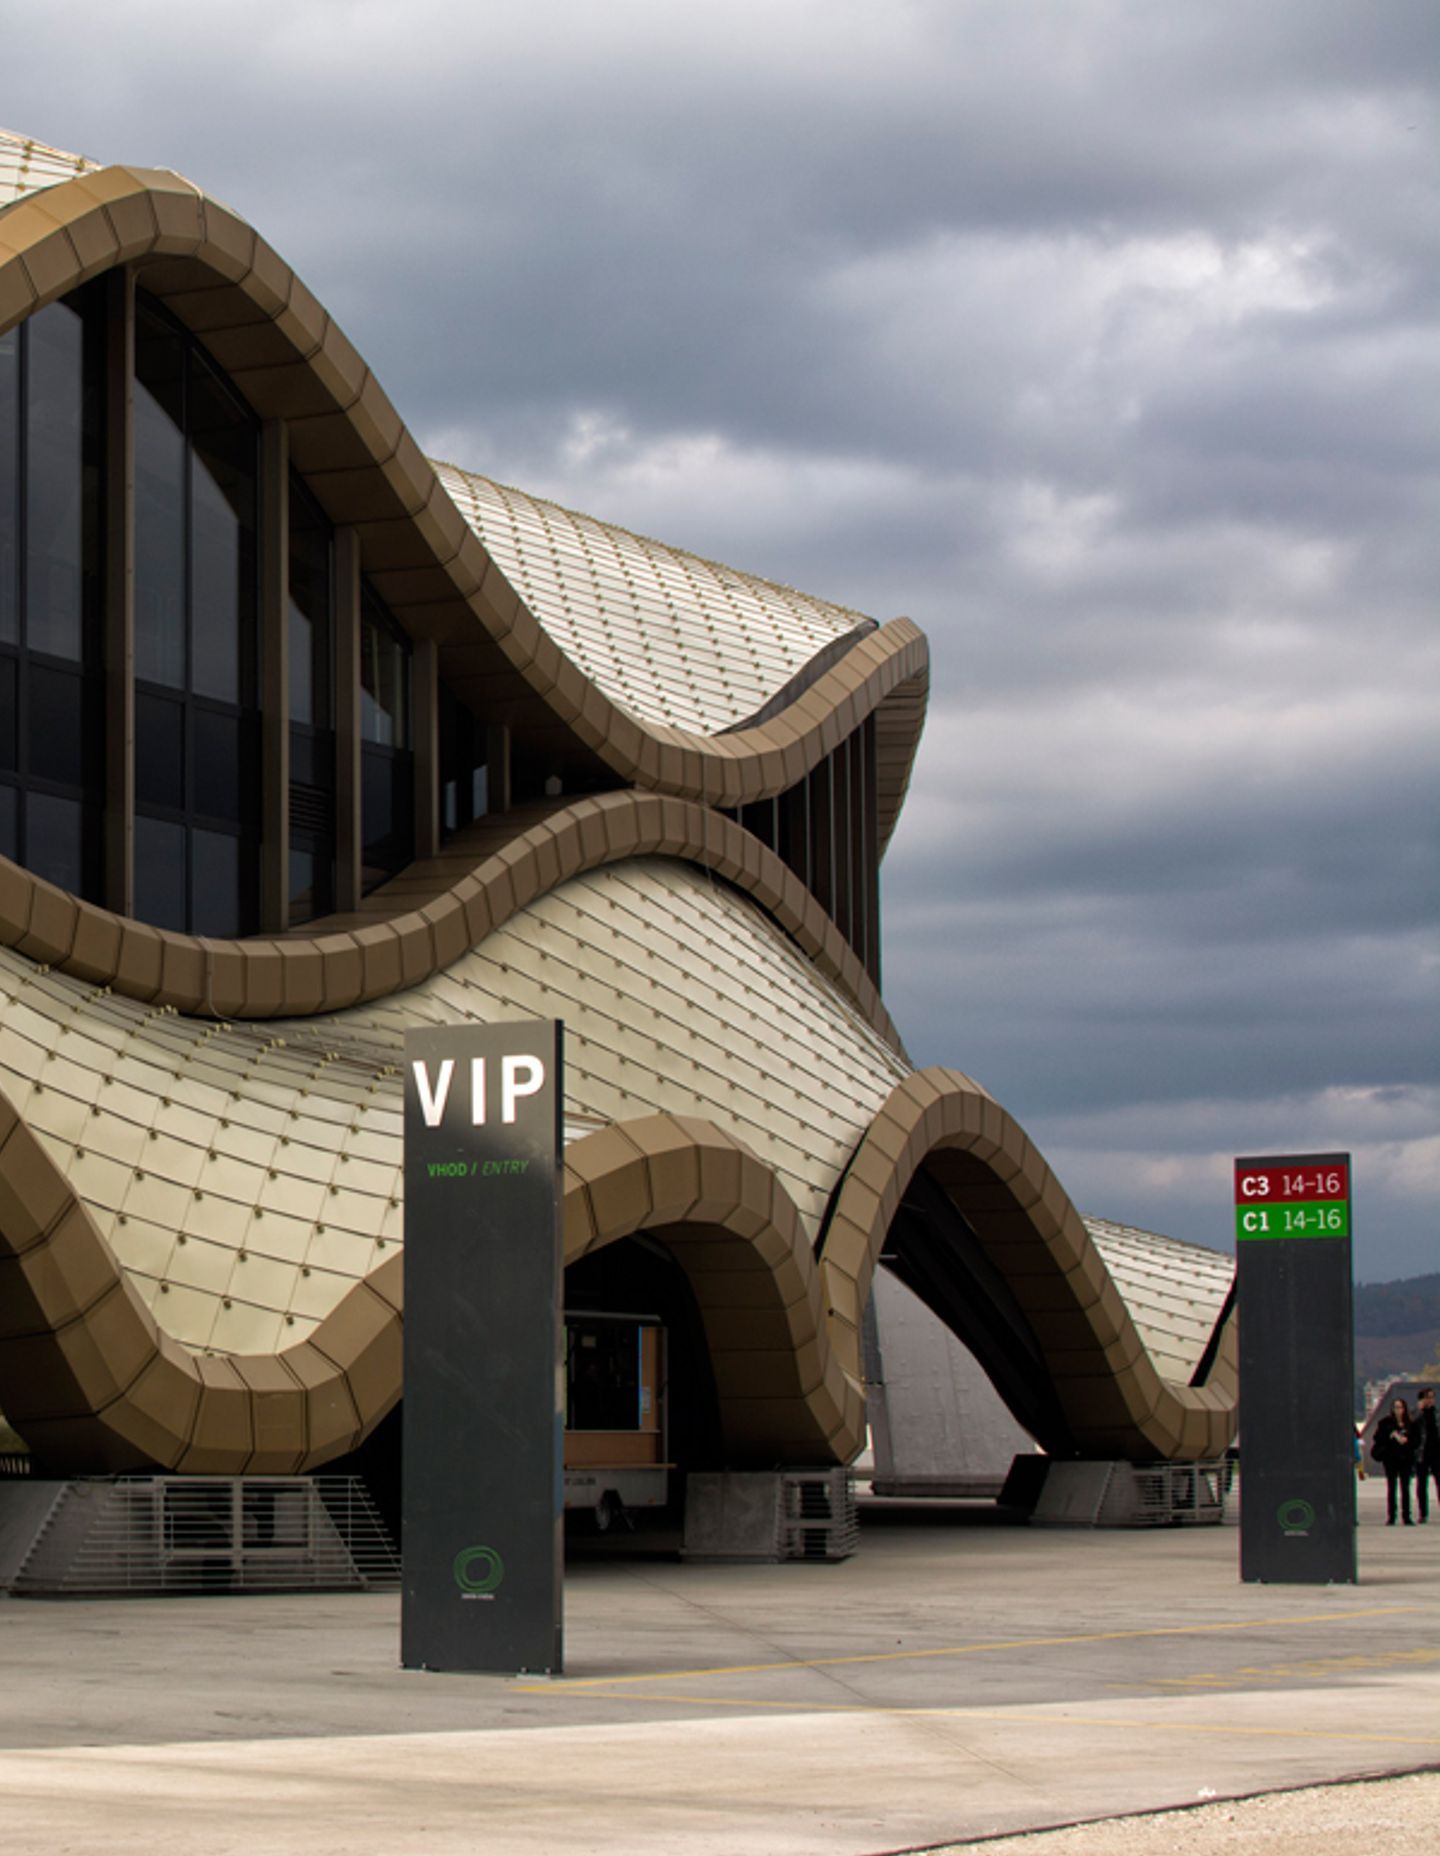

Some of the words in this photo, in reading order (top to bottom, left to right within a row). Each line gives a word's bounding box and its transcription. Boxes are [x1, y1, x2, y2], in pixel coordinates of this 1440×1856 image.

[412, 1054, 545, 1127] VIP
[426, 1162, 467, 1177] VHOD
[481, 1160, 529, 1177] ENTRY
[1242, 1175, 1269, 1196] C3
[1282, 1172, 1340, 1195] 14-16
[1243, 1211, 1269, 1231] C1
[1284, 1208, 1341, 1231] 14-16
